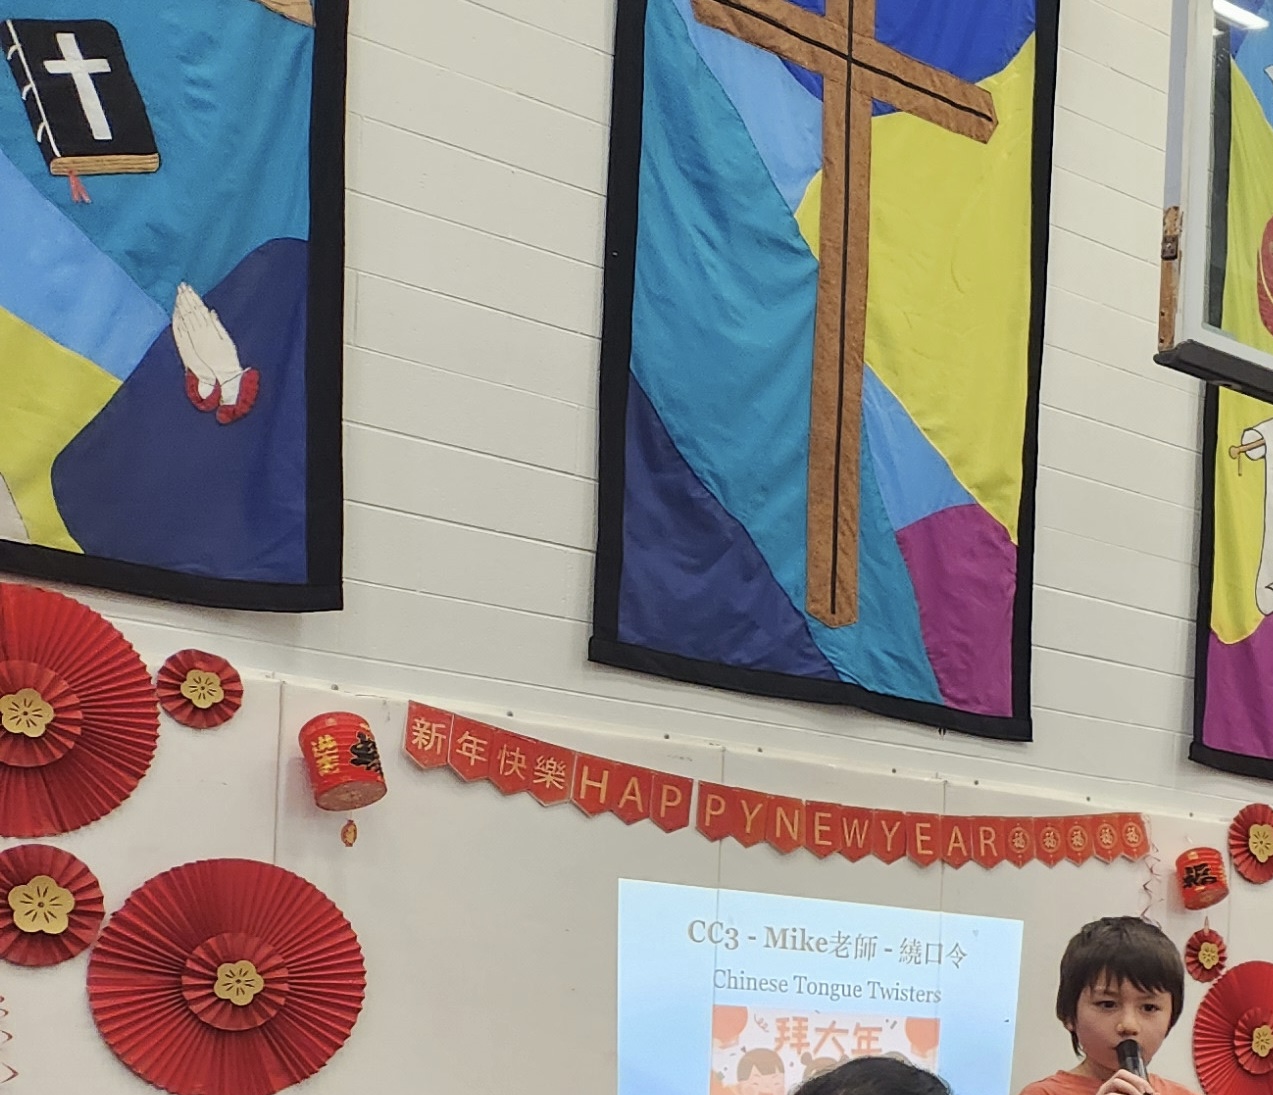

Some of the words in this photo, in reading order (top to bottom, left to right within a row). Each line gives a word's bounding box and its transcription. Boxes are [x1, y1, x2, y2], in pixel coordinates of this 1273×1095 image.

[411, 716, 568, 791] 新年快樂
[687, 918, 740, 950] CC3
[898, 936, 969, 969] 繞口令
[712, 968, 789, 994] Chinese
[793, 975, 863, 1002] Tongue
[867, 980, 942, 1004] Twisters
[774, 1016, 883, 1057] 拜大年
